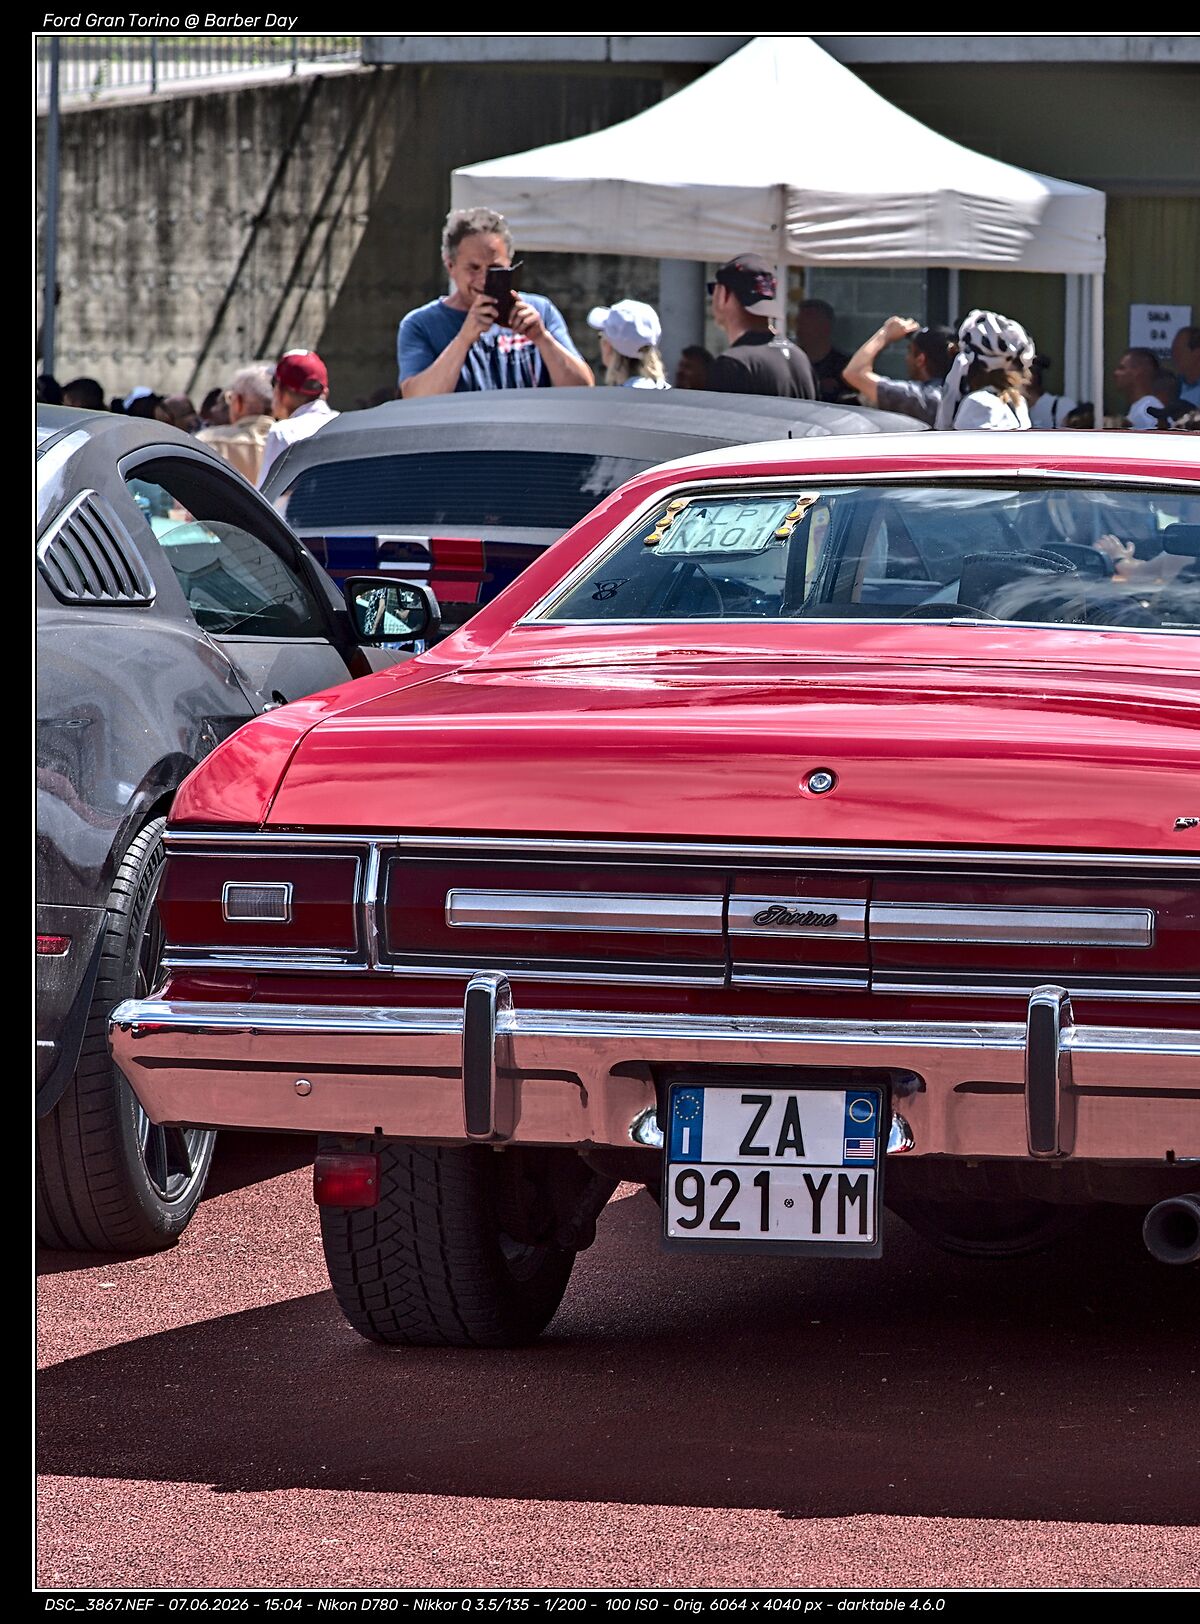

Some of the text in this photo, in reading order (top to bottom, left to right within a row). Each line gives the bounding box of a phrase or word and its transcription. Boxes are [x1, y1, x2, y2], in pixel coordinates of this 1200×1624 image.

[753, 904, 839, 928] Torino
[681, 1126, 691, 1155] I
[738, 1094, 806, 1157] ZA
[674, 1168, 869, 1235] 921 YM
